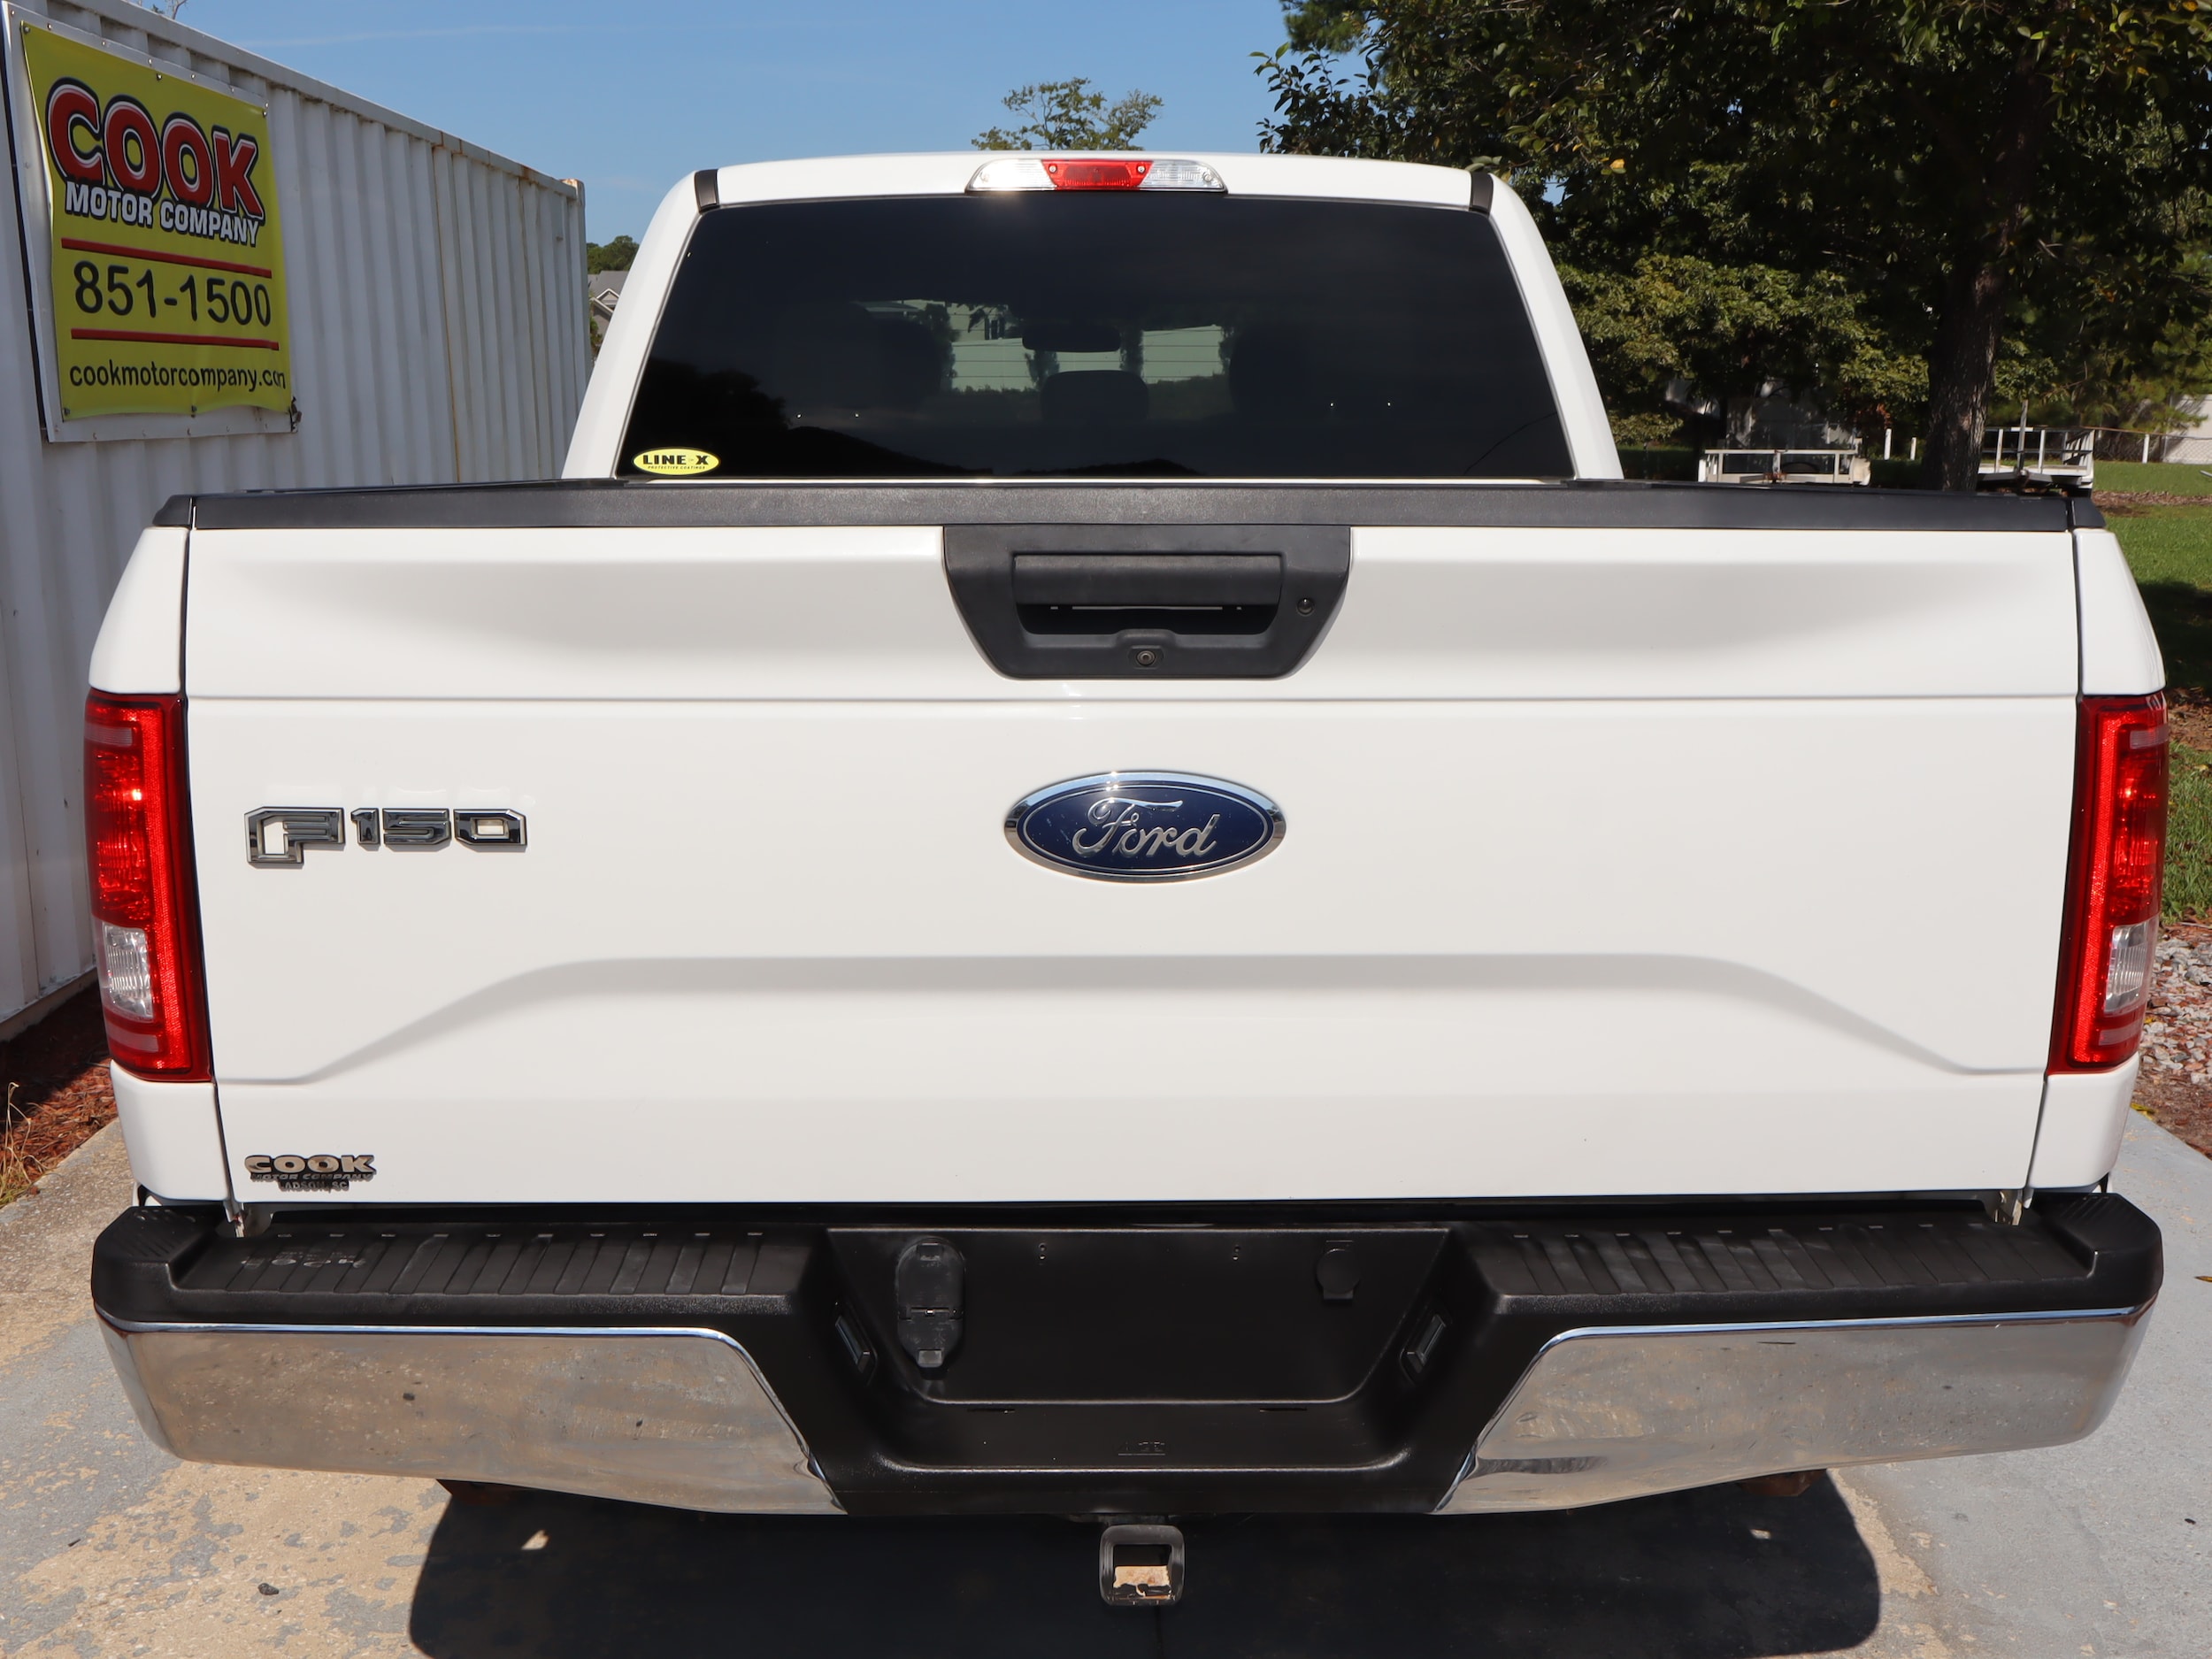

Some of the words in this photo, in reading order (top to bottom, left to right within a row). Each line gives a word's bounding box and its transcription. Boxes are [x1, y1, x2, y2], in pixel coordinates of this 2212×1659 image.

[47, 78, 265, 220] COOK
[65, 180, 153, 227] MOTOR
[159, 200, 259, 246] COMPANY
[74, 260, 272, 326] 851-1500
[1071, 796, 1220, 857] Ford
[244, 1155, 376, 1174] COOK
